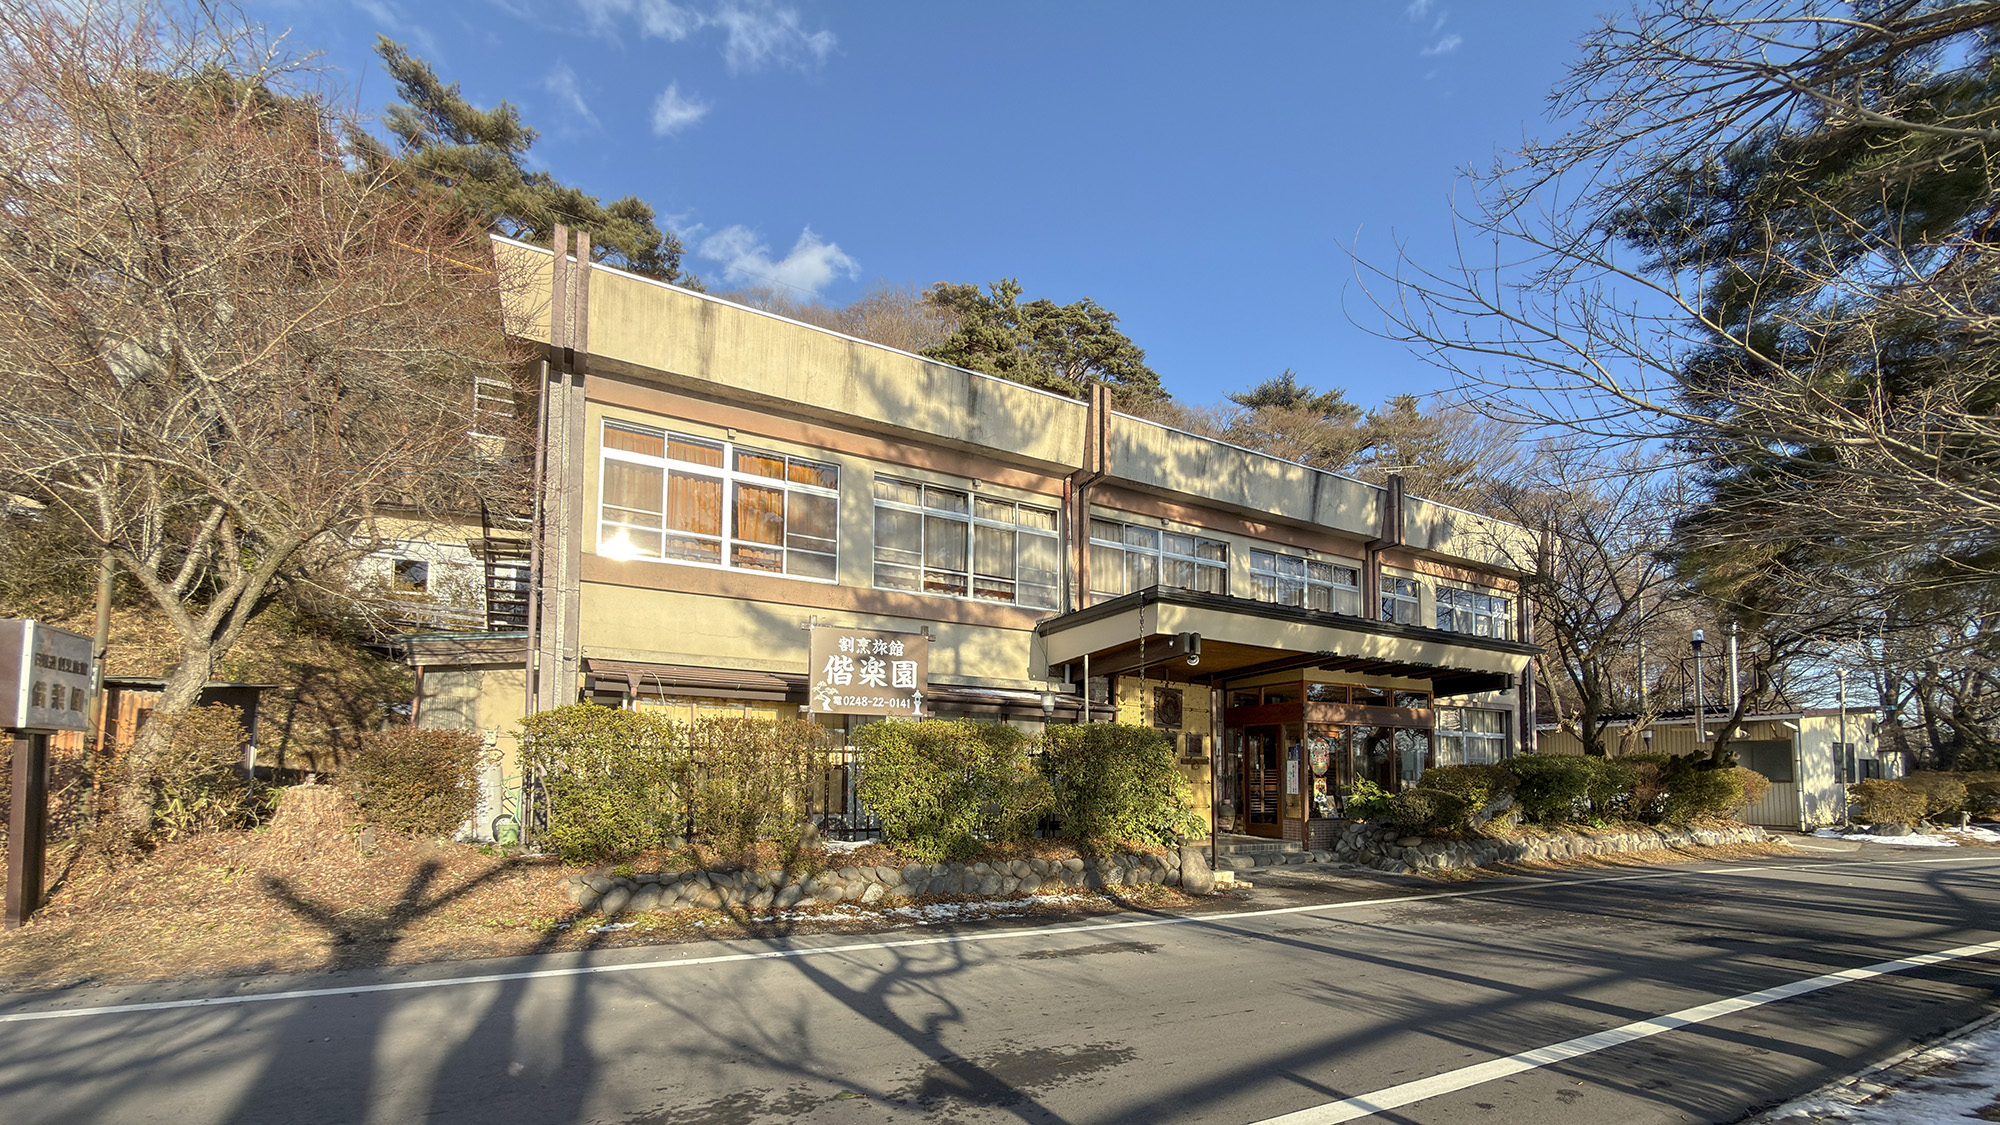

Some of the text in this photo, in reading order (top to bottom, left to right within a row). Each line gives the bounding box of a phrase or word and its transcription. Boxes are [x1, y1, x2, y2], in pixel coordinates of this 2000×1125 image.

[838, 636, 905, 657] 割烹旅館
[822, 655, 918, 689] 偕楽園
